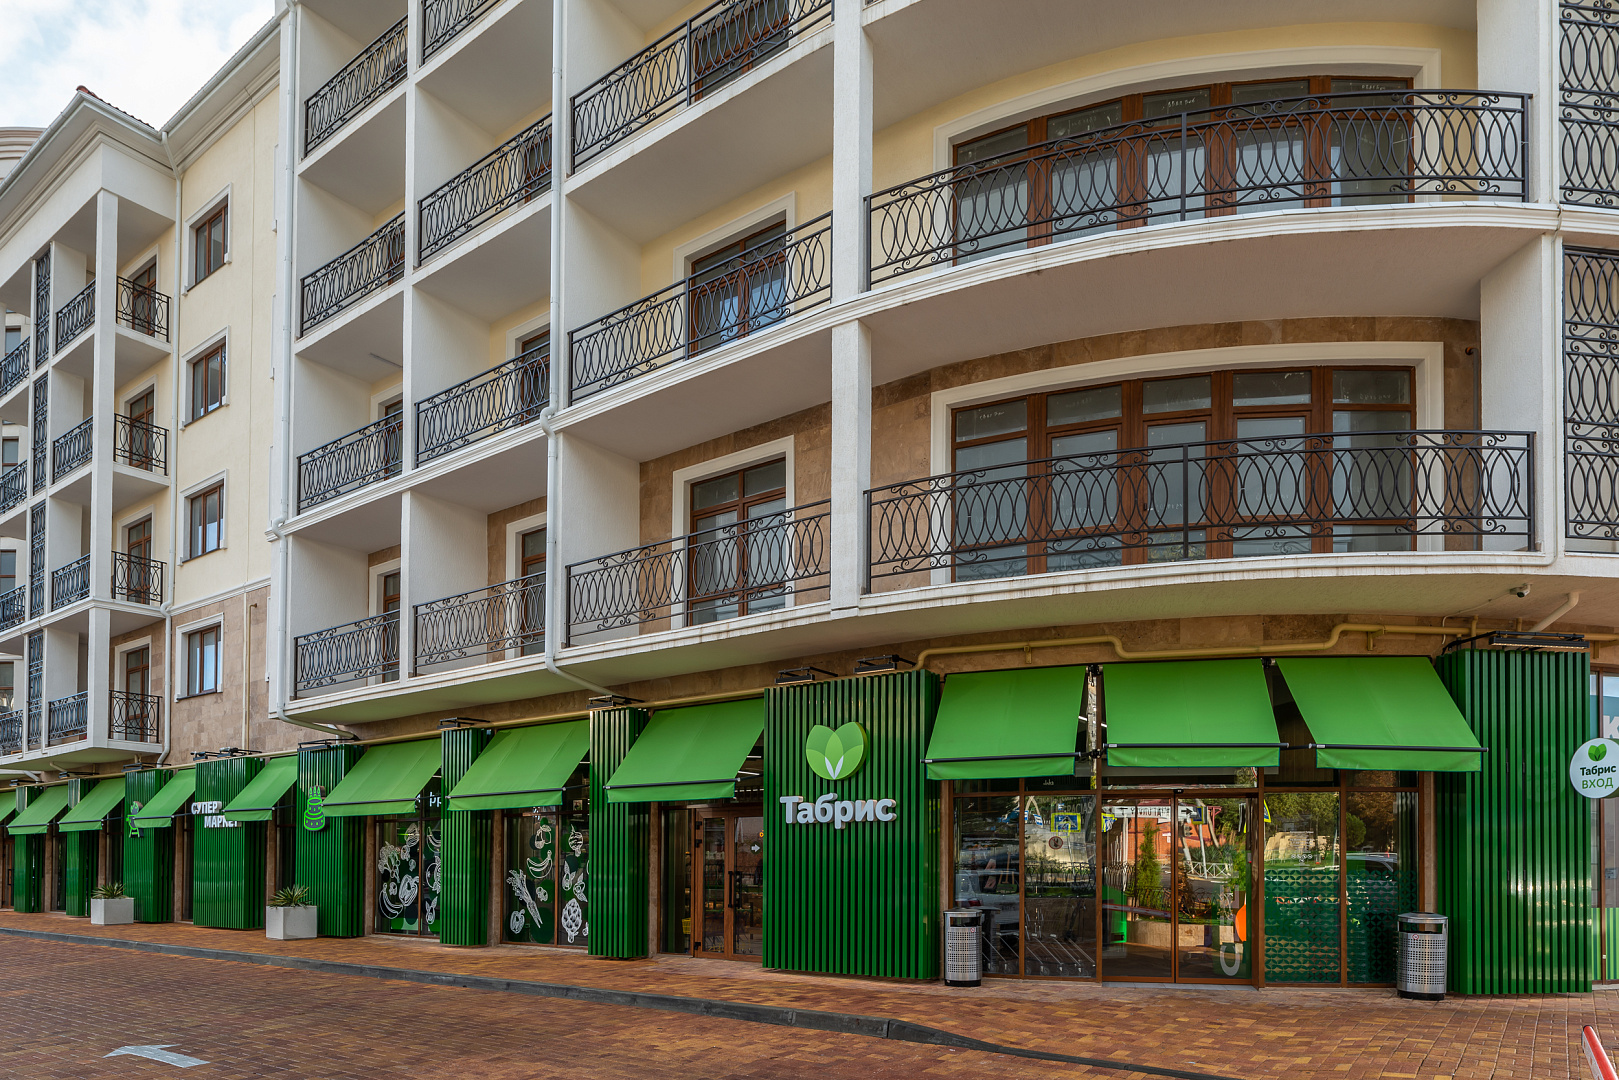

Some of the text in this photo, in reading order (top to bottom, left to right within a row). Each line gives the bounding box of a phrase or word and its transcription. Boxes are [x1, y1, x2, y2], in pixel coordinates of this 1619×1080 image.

[1580, 765, 1616, 776] Табрис
[1582, 777, 1613, 789] ВХОД
[191, 801, 221, 814] СУПЕР
[779, 793, 897, 829] Табрис
